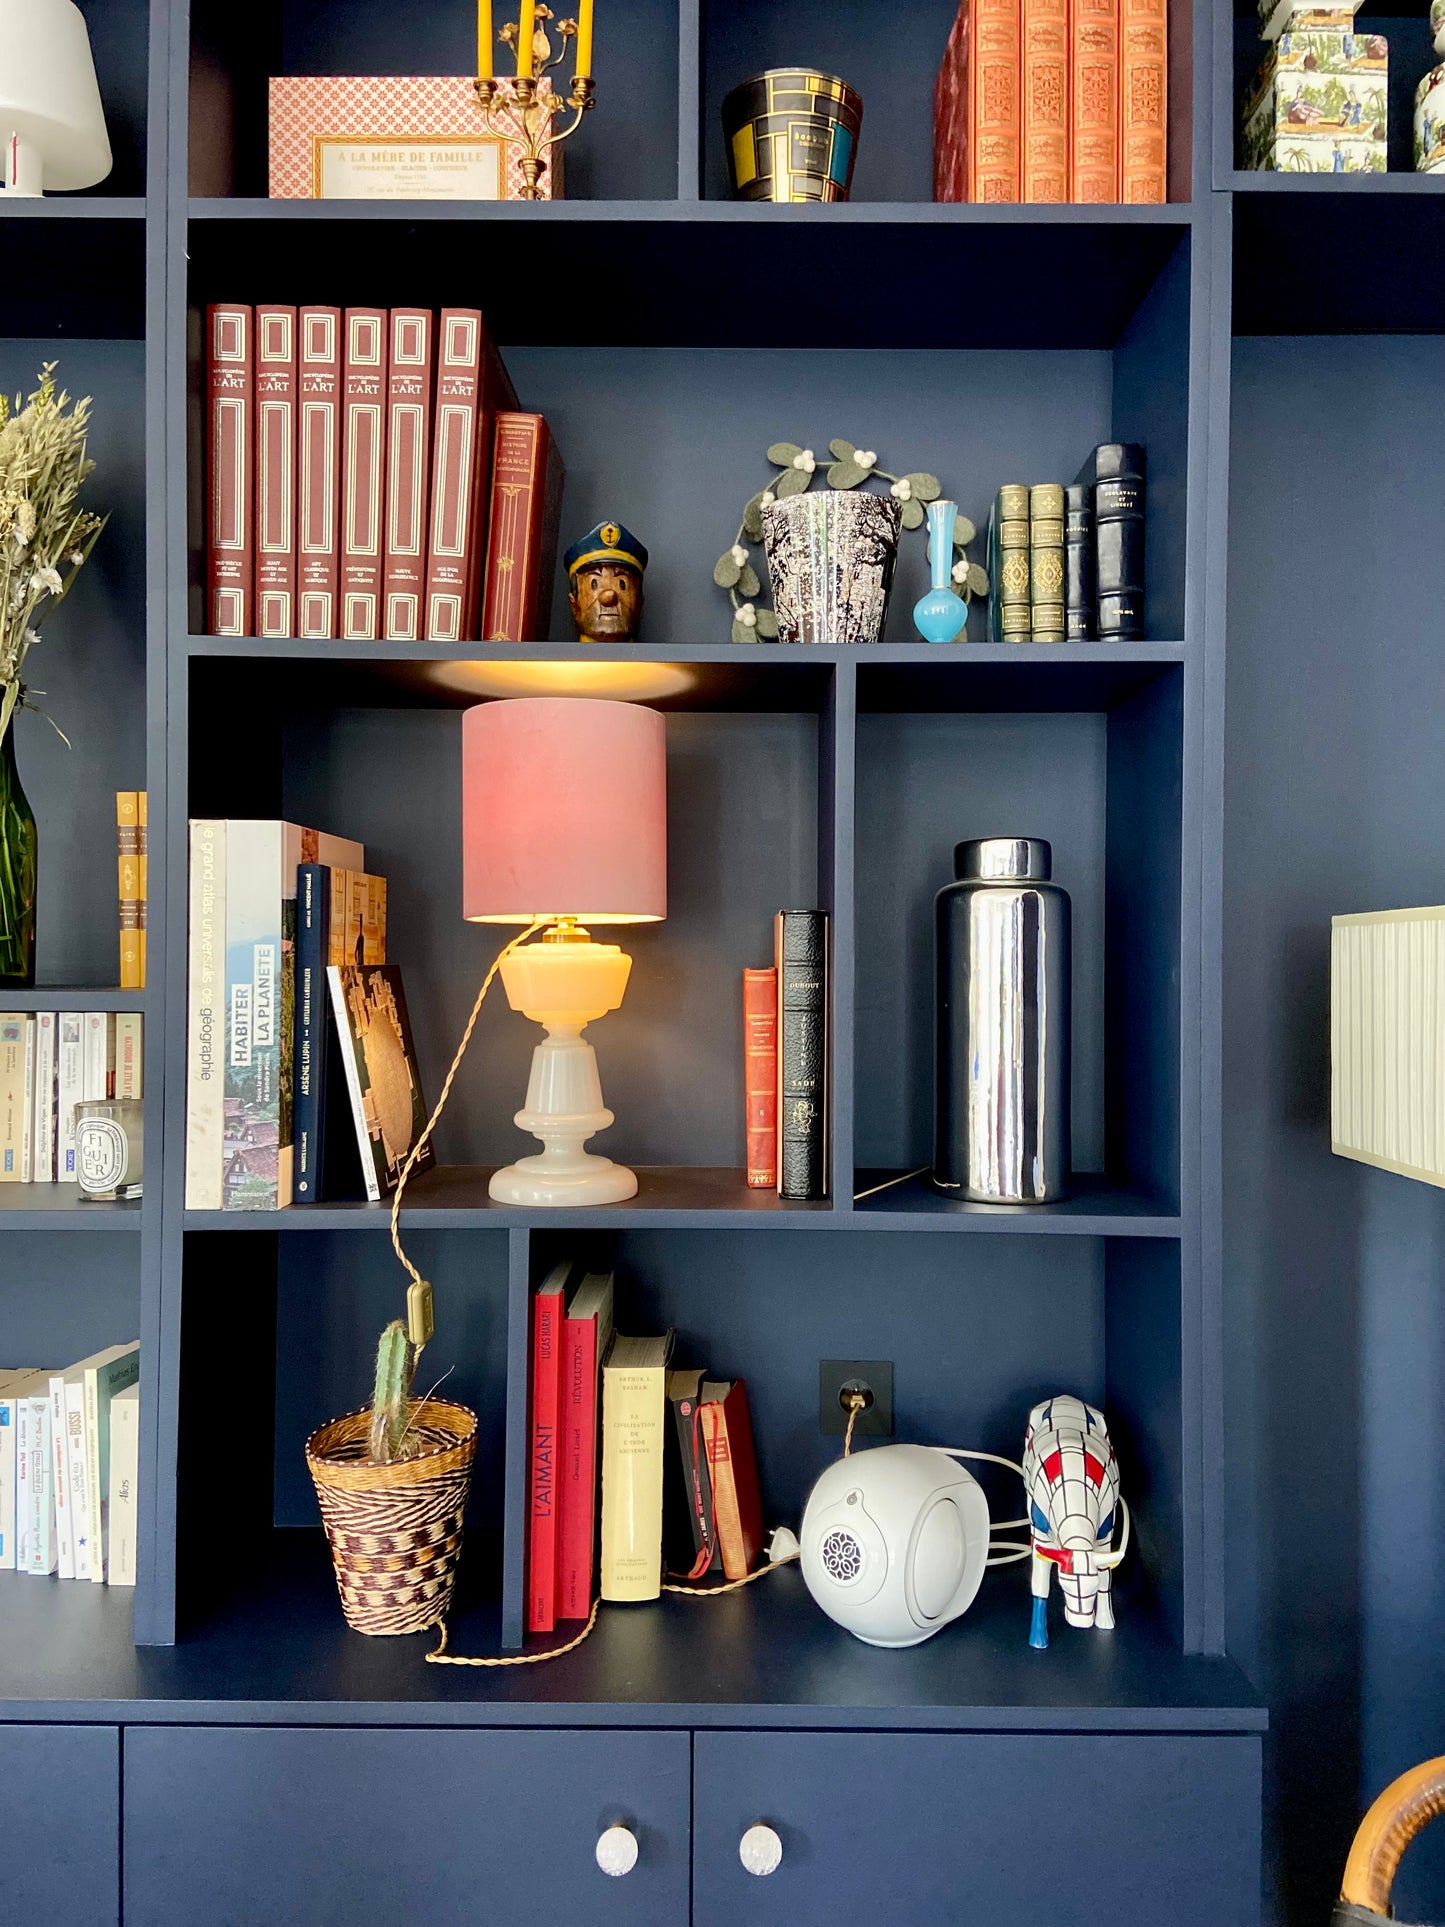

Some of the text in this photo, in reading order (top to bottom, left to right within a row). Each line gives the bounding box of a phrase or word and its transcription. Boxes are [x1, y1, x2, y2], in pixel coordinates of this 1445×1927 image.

[351, 152, 366, 162] LA
[410, 152, 424, 162] DE
[429, 152, 482, 162] FAMILLE
[213, 378, 245, 388] L'ART
[259, 382, 289, 391] L'ART
[303, 382, 334, 392] L'ART
[348, 384, 379, 394] L'ART
[391, 384, 422, 395] L'ART
[442, 385, 474, 396] L'ART
[498, 457, 530, 466] FRANCE
[200, 842, 215, 879] grand
[203, 883, 215, 915] atlas
[202, 918, 215, 983] universalis
[202, 988, 214, 1004] de
[235, 989, 248, 1062] HABITER
[258, 1023, 270, 1041] LA
[199, 1007, 215, 1081] géographie
[300, 1040, 310, 1096] ARSÈNE LUPIN
[264, 1094, 270, 1102] de
[541, 1336, 551, 1359] LUCAS
[571, 1345, 582, 1404] RÉVOLUTION
[68, 1411, 82, 1436] BUSSI
[534, 1423, 553, 1518] L'AIMANT
[118, 1479, 129, 1504] Alias
